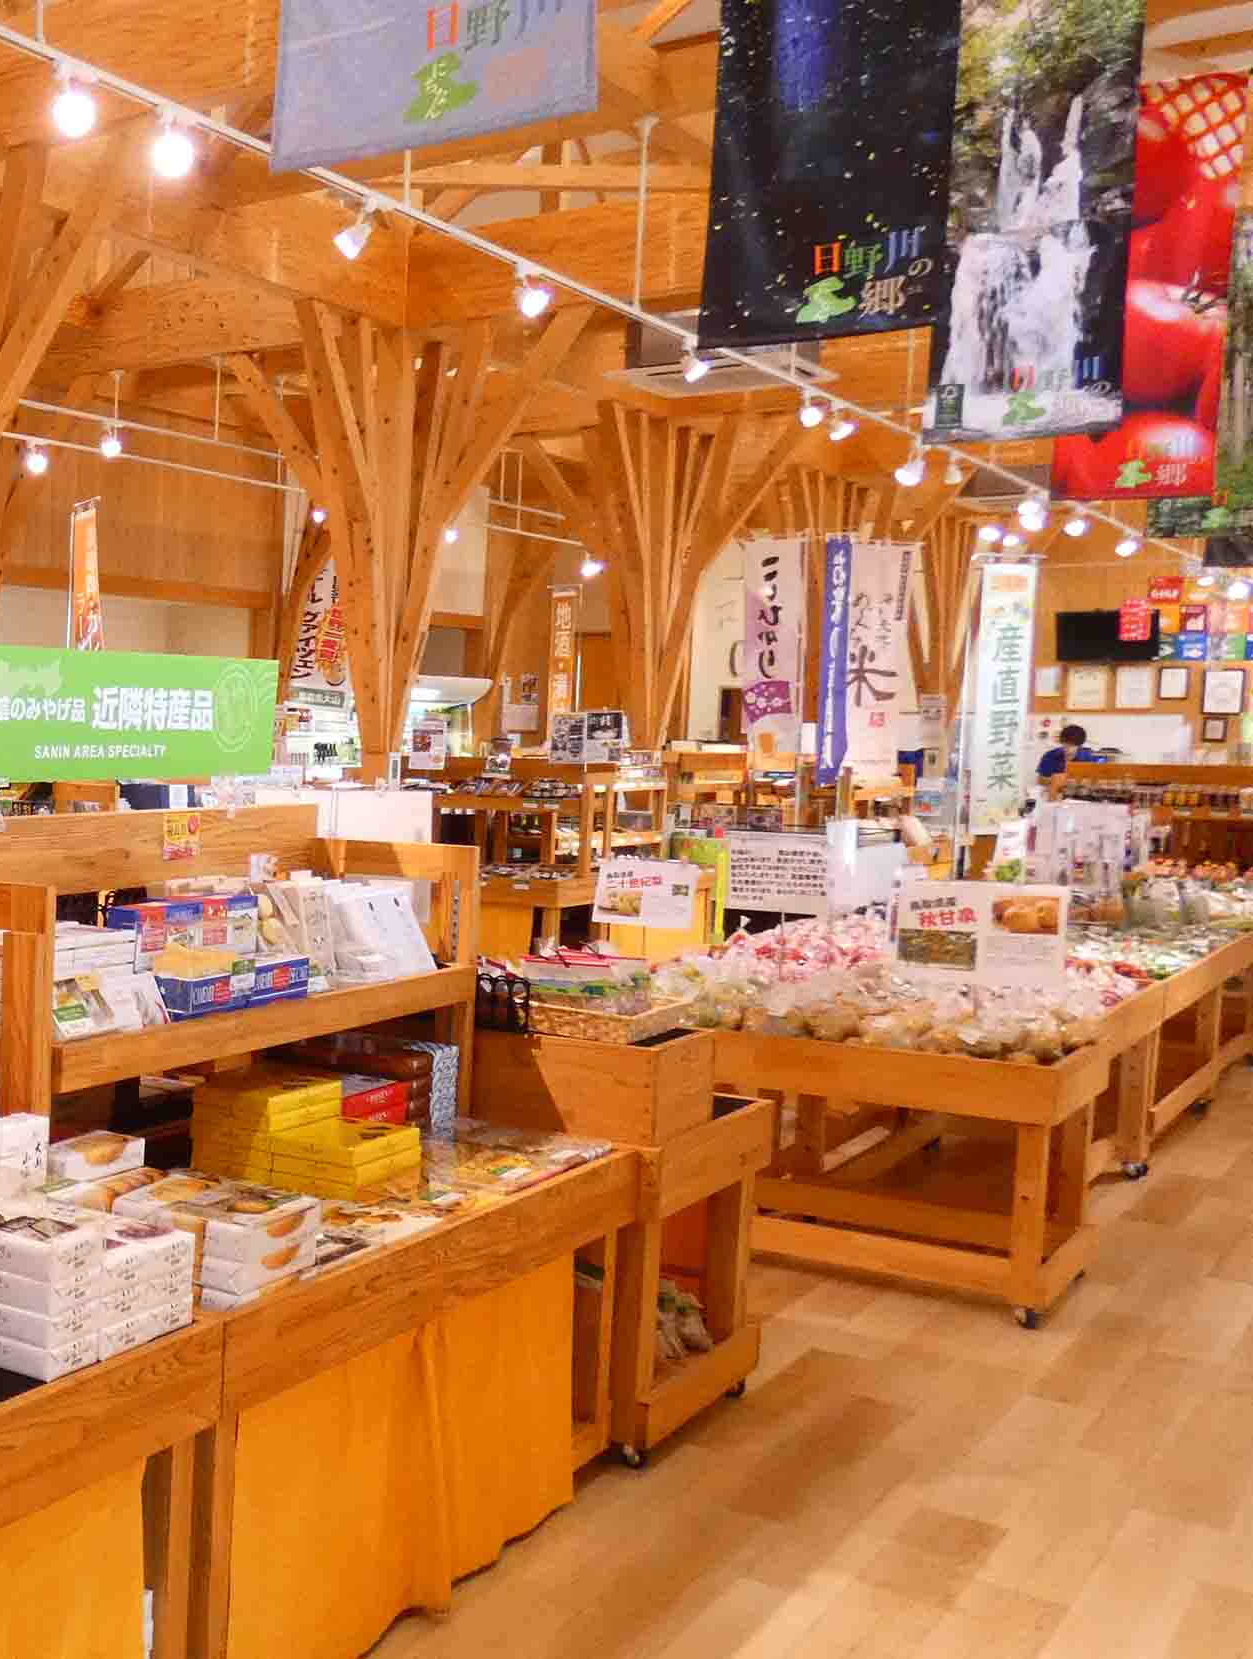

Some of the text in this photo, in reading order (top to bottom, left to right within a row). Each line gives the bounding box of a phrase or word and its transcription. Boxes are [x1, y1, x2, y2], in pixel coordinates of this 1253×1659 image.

[92, 687, 214, 731] 近隣特産品
[989, 623, 1024, 791] 産直野菜
[34, 743, 166, 760] SANIN AREA SPECIALTY
